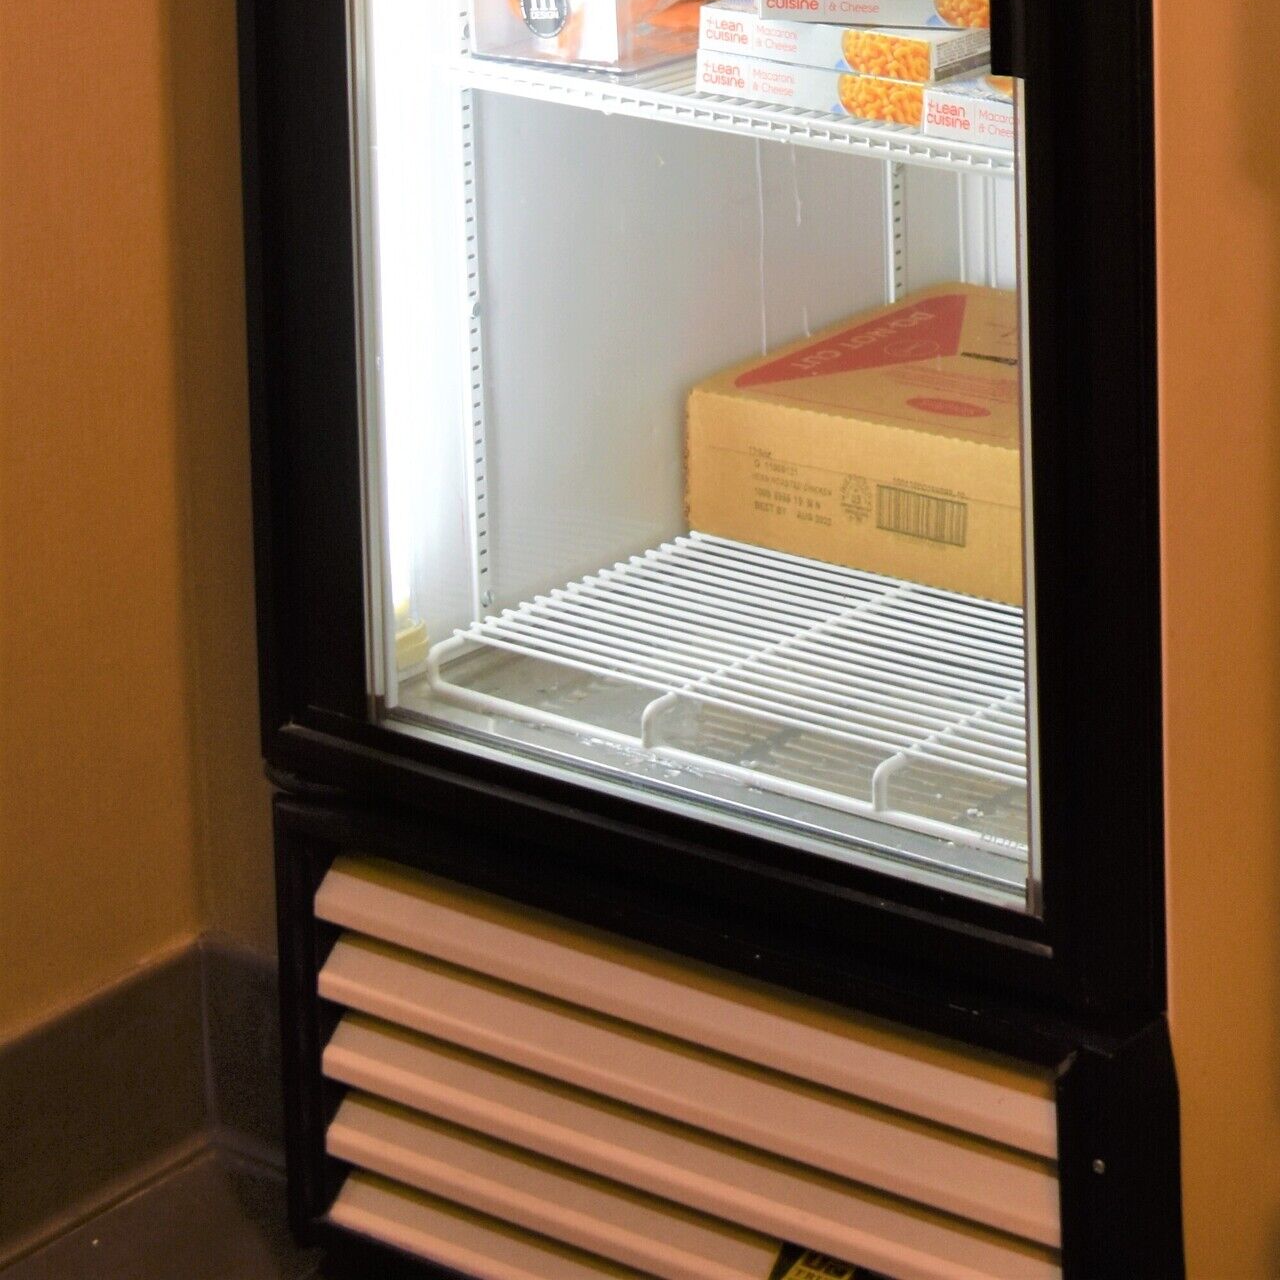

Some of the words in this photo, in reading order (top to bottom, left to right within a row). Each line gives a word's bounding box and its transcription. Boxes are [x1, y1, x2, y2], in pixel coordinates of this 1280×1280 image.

[840, 1, 880, 14] Cheese
[980, 109, 1014, 124] Macaro
[987, 124, 1014, 138] Chee
